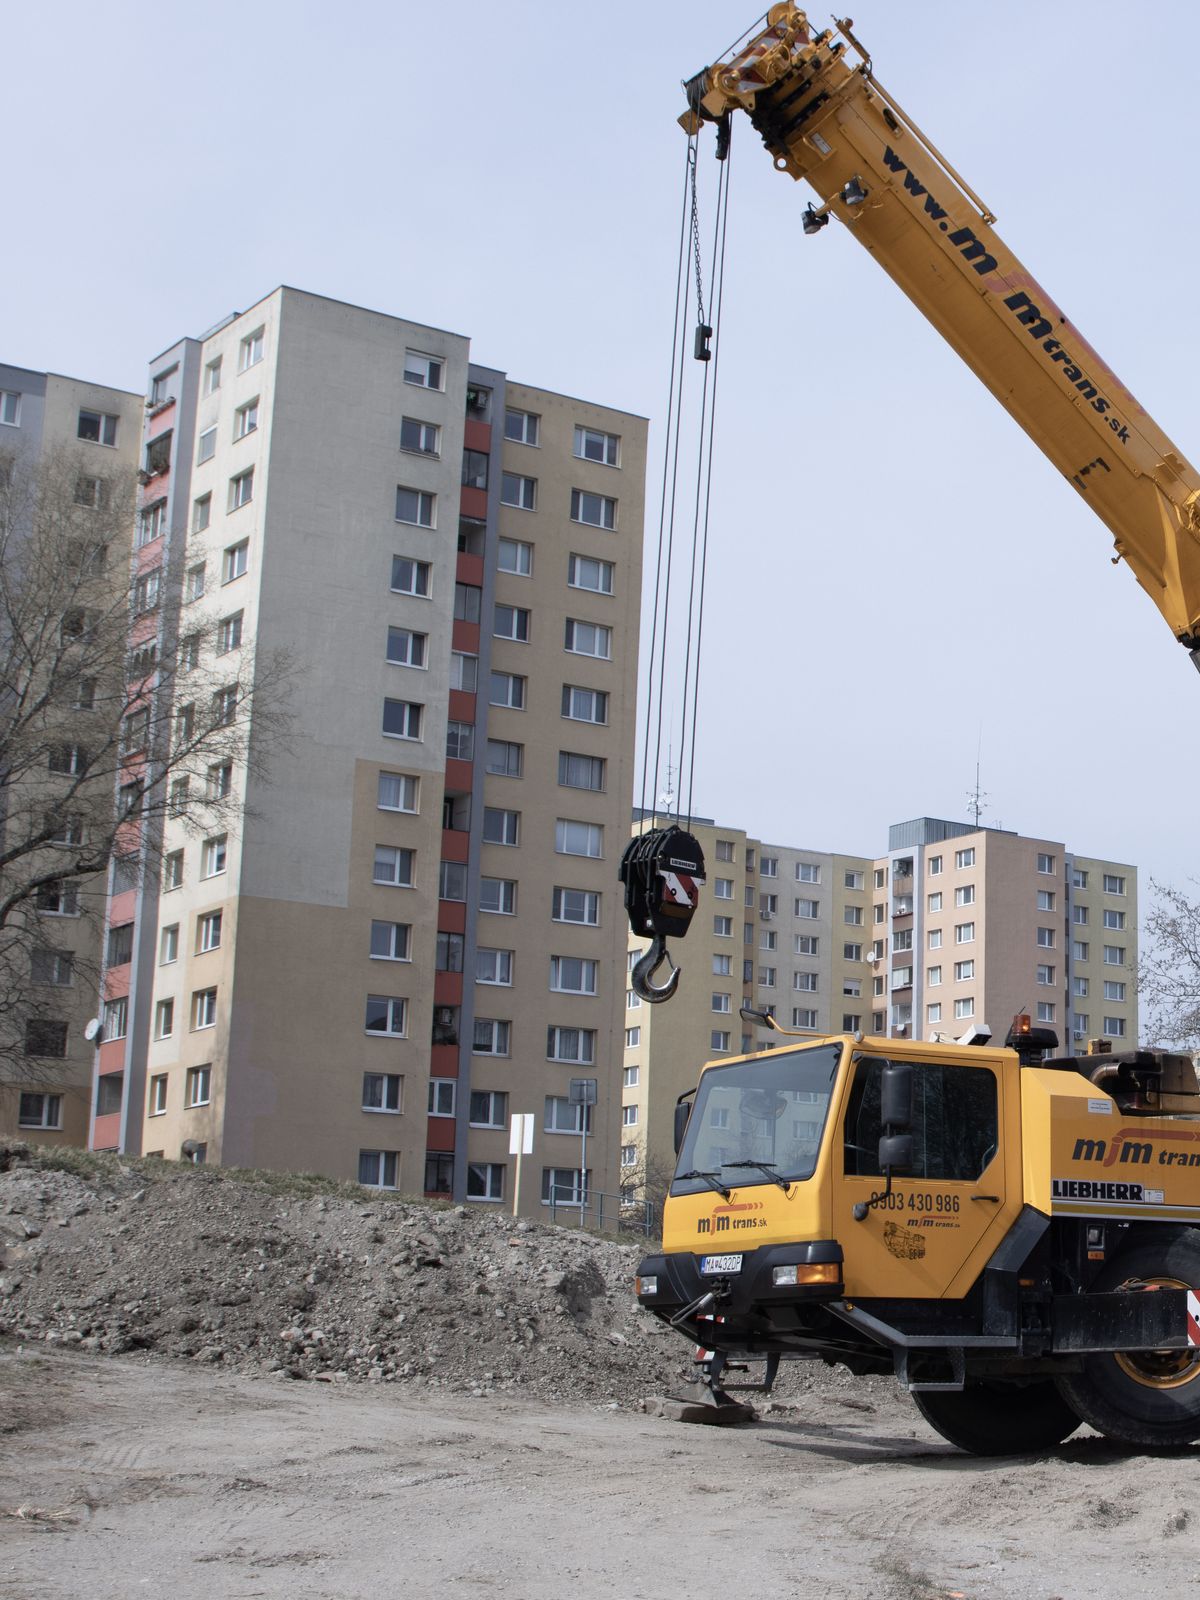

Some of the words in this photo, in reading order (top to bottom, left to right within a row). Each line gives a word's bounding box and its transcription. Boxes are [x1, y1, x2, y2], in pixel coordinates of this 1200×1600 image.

[1052, 1180, 1143, 1201] LIEBHERR
[871, 1191, 904, 1211] 0903
[908, 1193, 933, 1212] 430
[936, 1194, 960, 1213] 986
